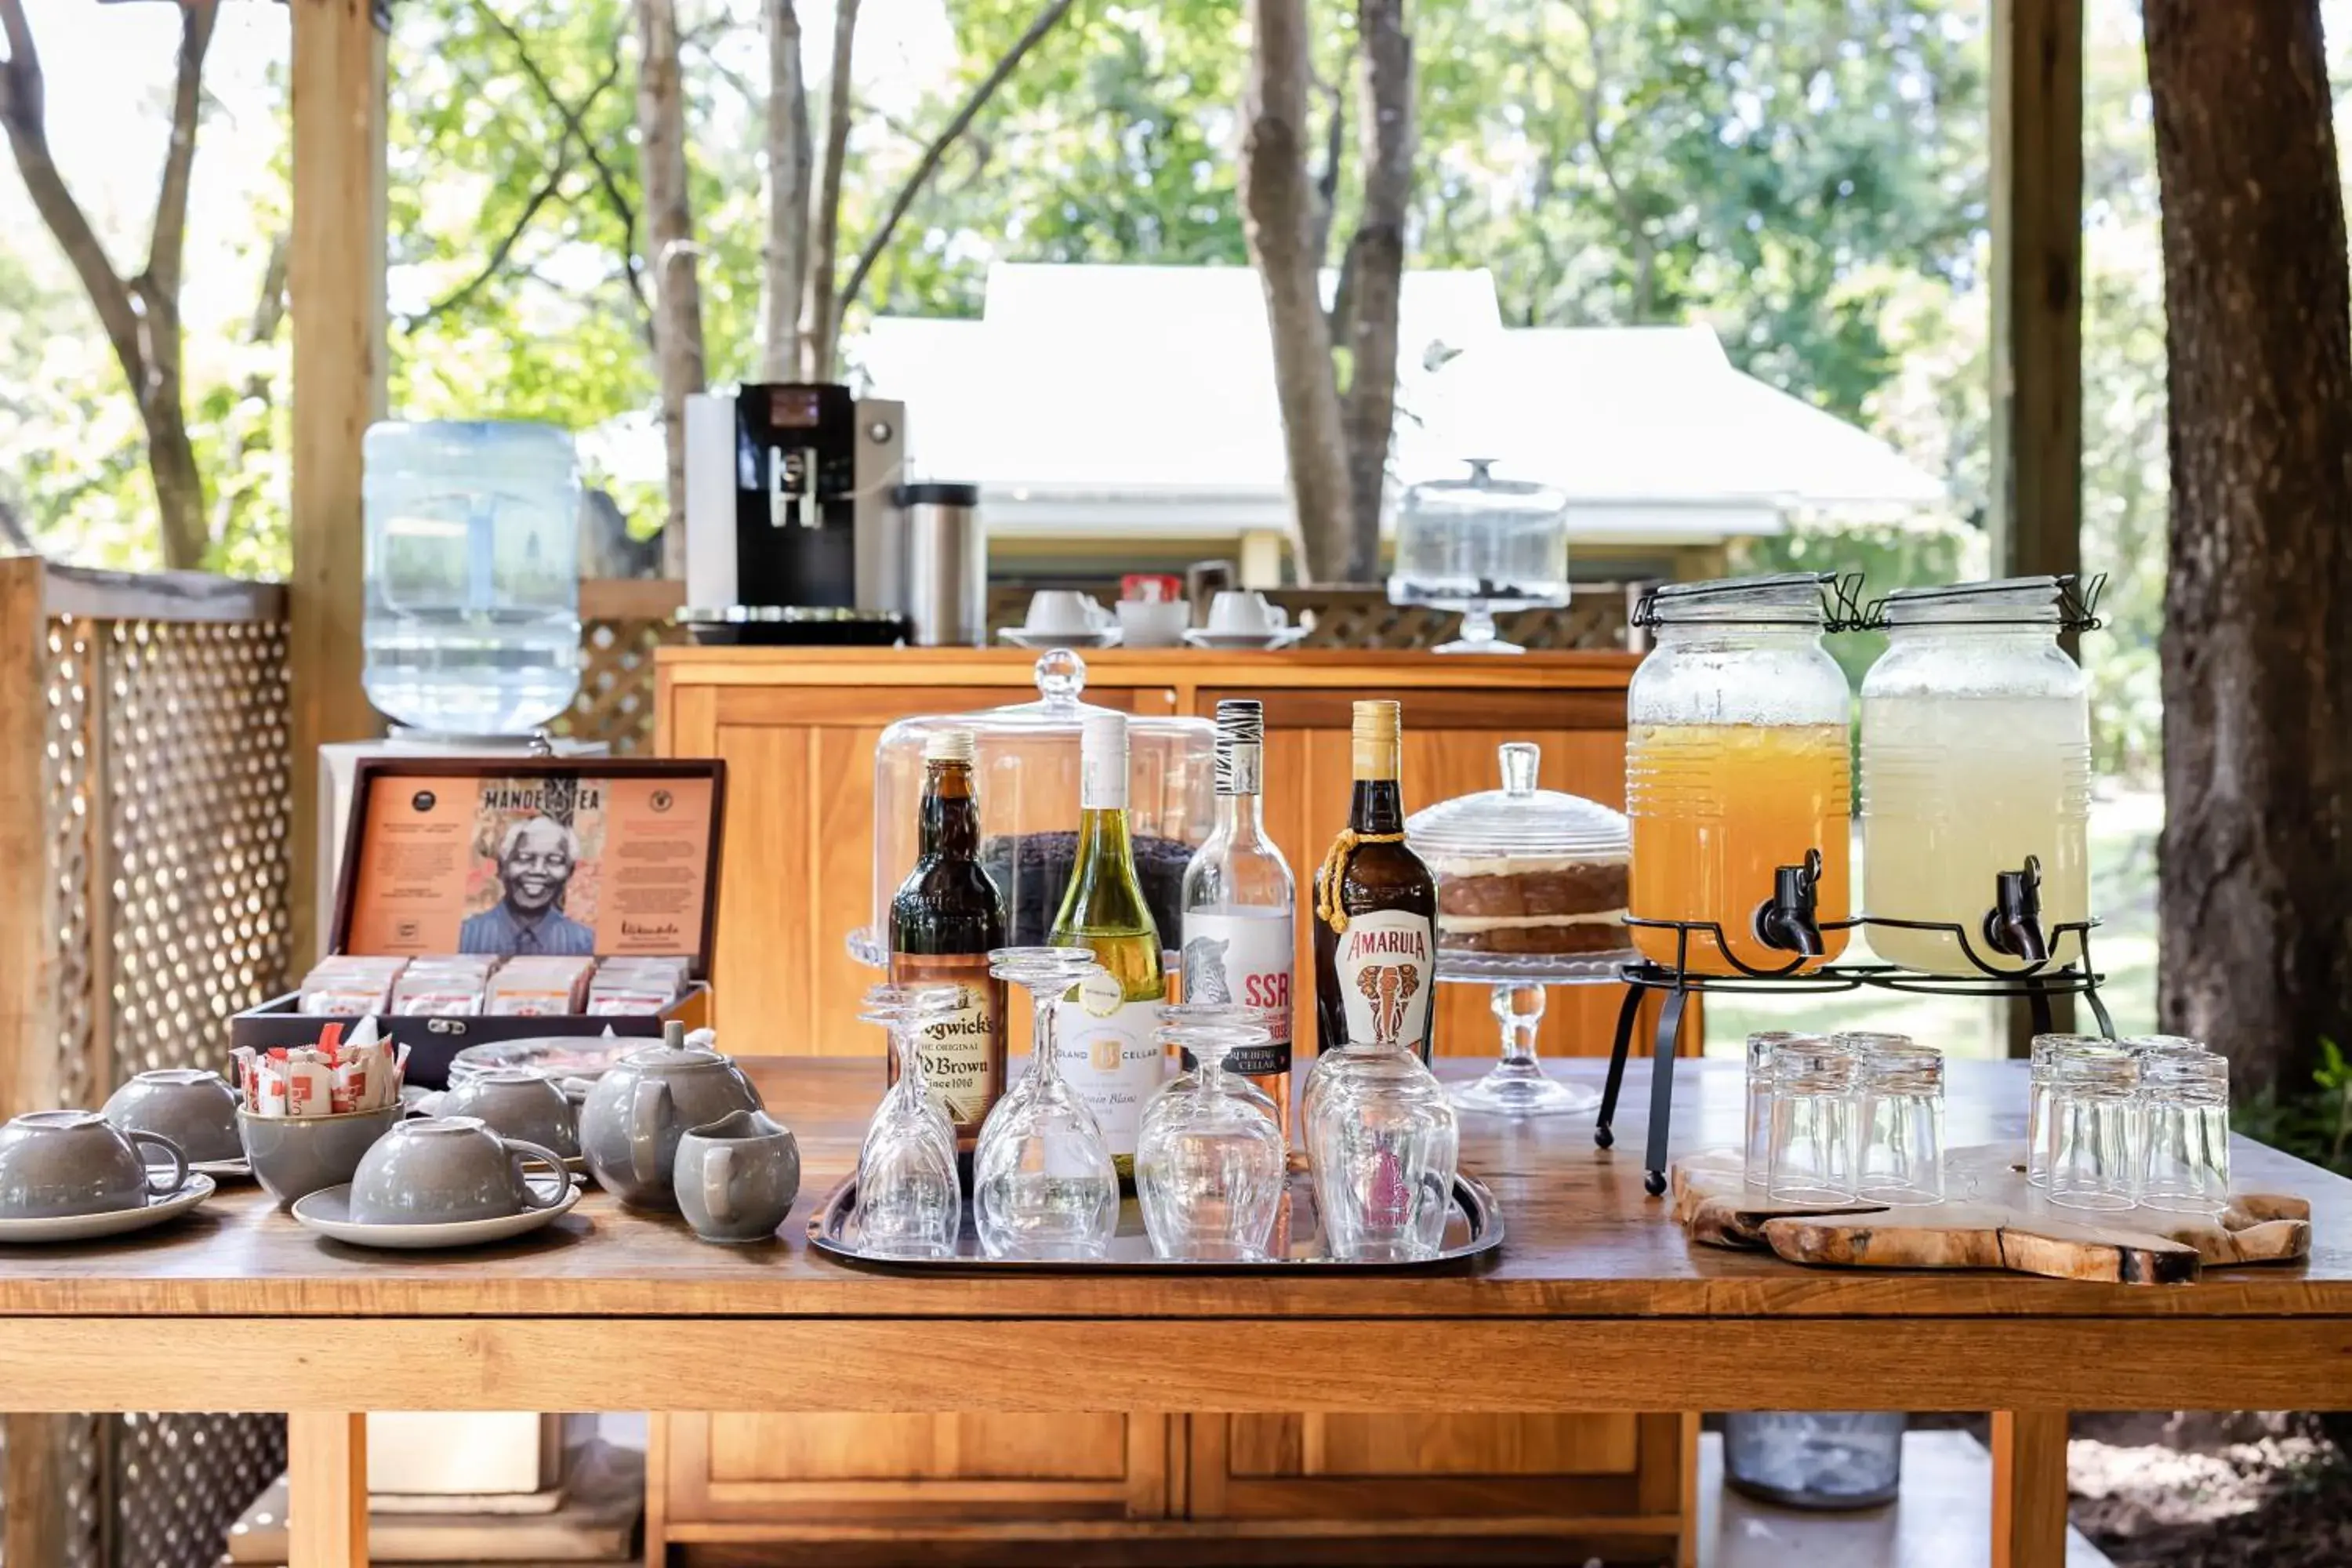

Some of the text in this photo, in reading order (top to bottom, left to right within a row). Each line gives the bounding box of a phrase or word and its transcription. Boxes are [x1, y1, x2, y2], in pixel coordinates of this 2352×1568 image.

[1347, 930, 1425, 962] AMARULA
[1245, 973, 1288, 1008] SSR
[935, 1043, 978, 1051] ORIGINAL
[1122, 1048, 1158, 1059] CELLAR
[937, 1057, 988, 1075] Brown
